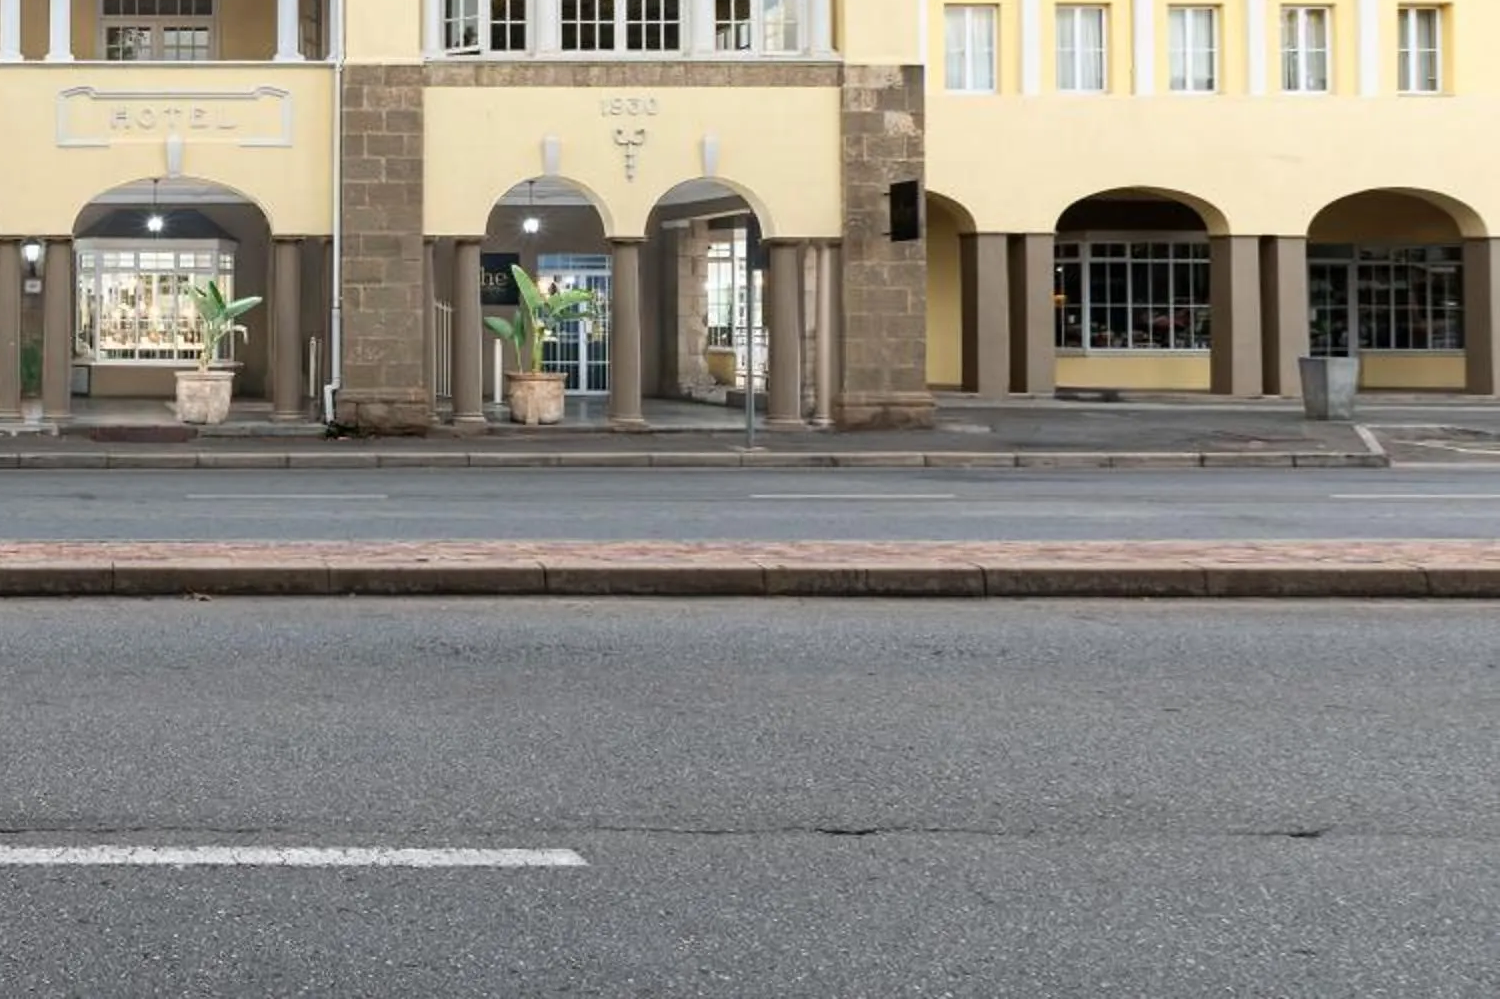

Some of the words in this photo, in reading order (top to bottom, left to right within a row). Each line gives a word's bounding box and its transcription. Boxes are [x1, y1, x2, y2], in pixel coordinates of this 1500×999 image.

[110, 104, 238, 130] HOTEL
[600, 97, 659, 117] 1930
[481, 266, 508, 288] he
